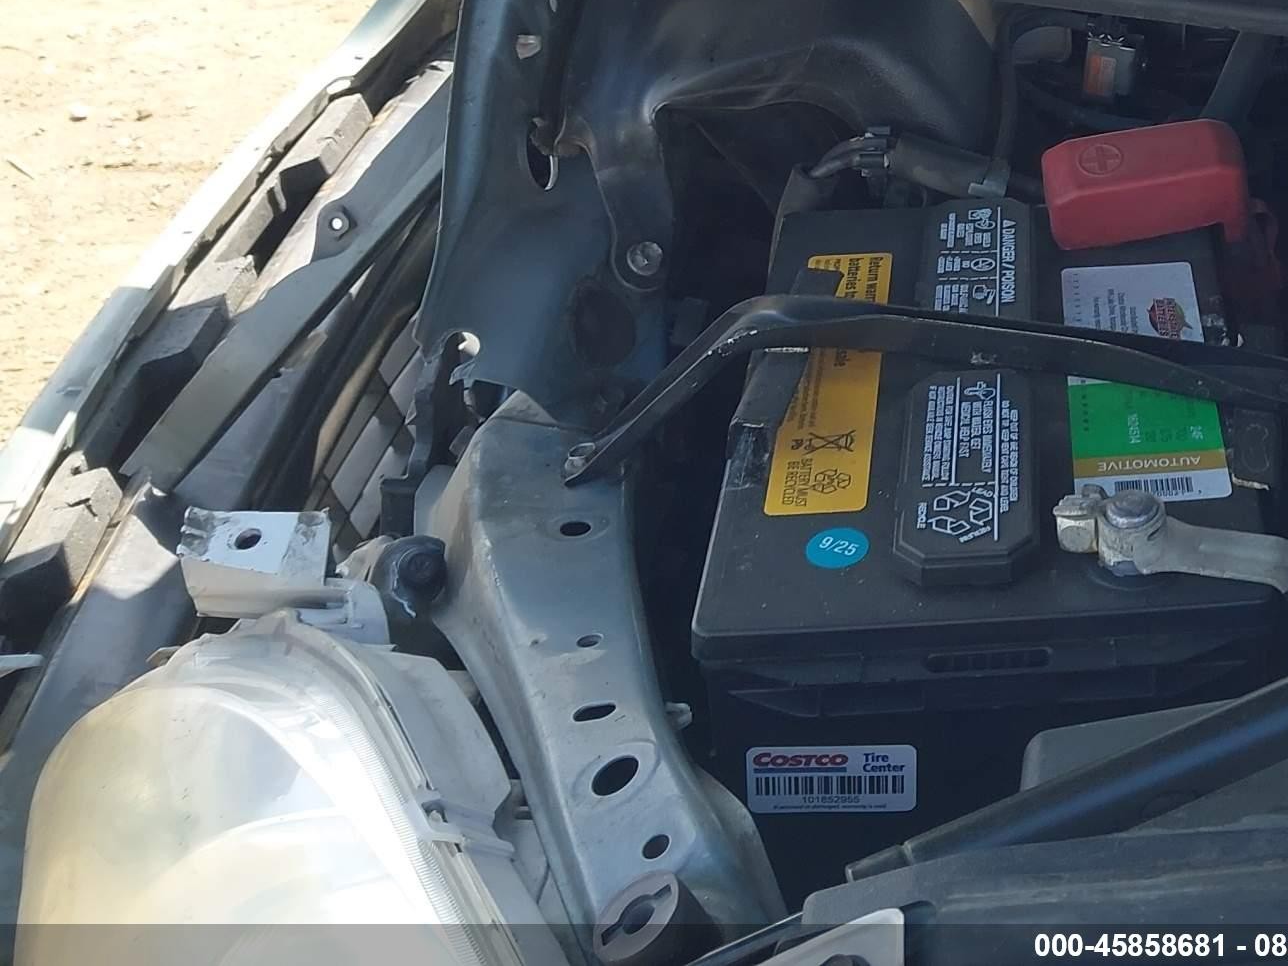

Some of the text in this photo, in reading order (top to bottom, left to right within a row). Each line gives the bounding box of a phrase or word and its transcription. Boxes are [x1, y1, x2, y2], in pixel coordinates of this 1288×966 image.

[1002, 228, 1015, 262] DANGER
[845, 258, 864, 290] batteries
[868, 257, 883, 282] Return
[1001, 270, 1015, 303] POISON
[1098, 455, 1201, 471] AUTOMOTIVE
[782, 461, 799, 506] BE RECYCLED
[795, 458, 812, 507] BATTERY MUST
[819, 536, 860, 556] 9/25
[863, 753, 889, 762] Tire
[863, 763, 905, 773] Center
